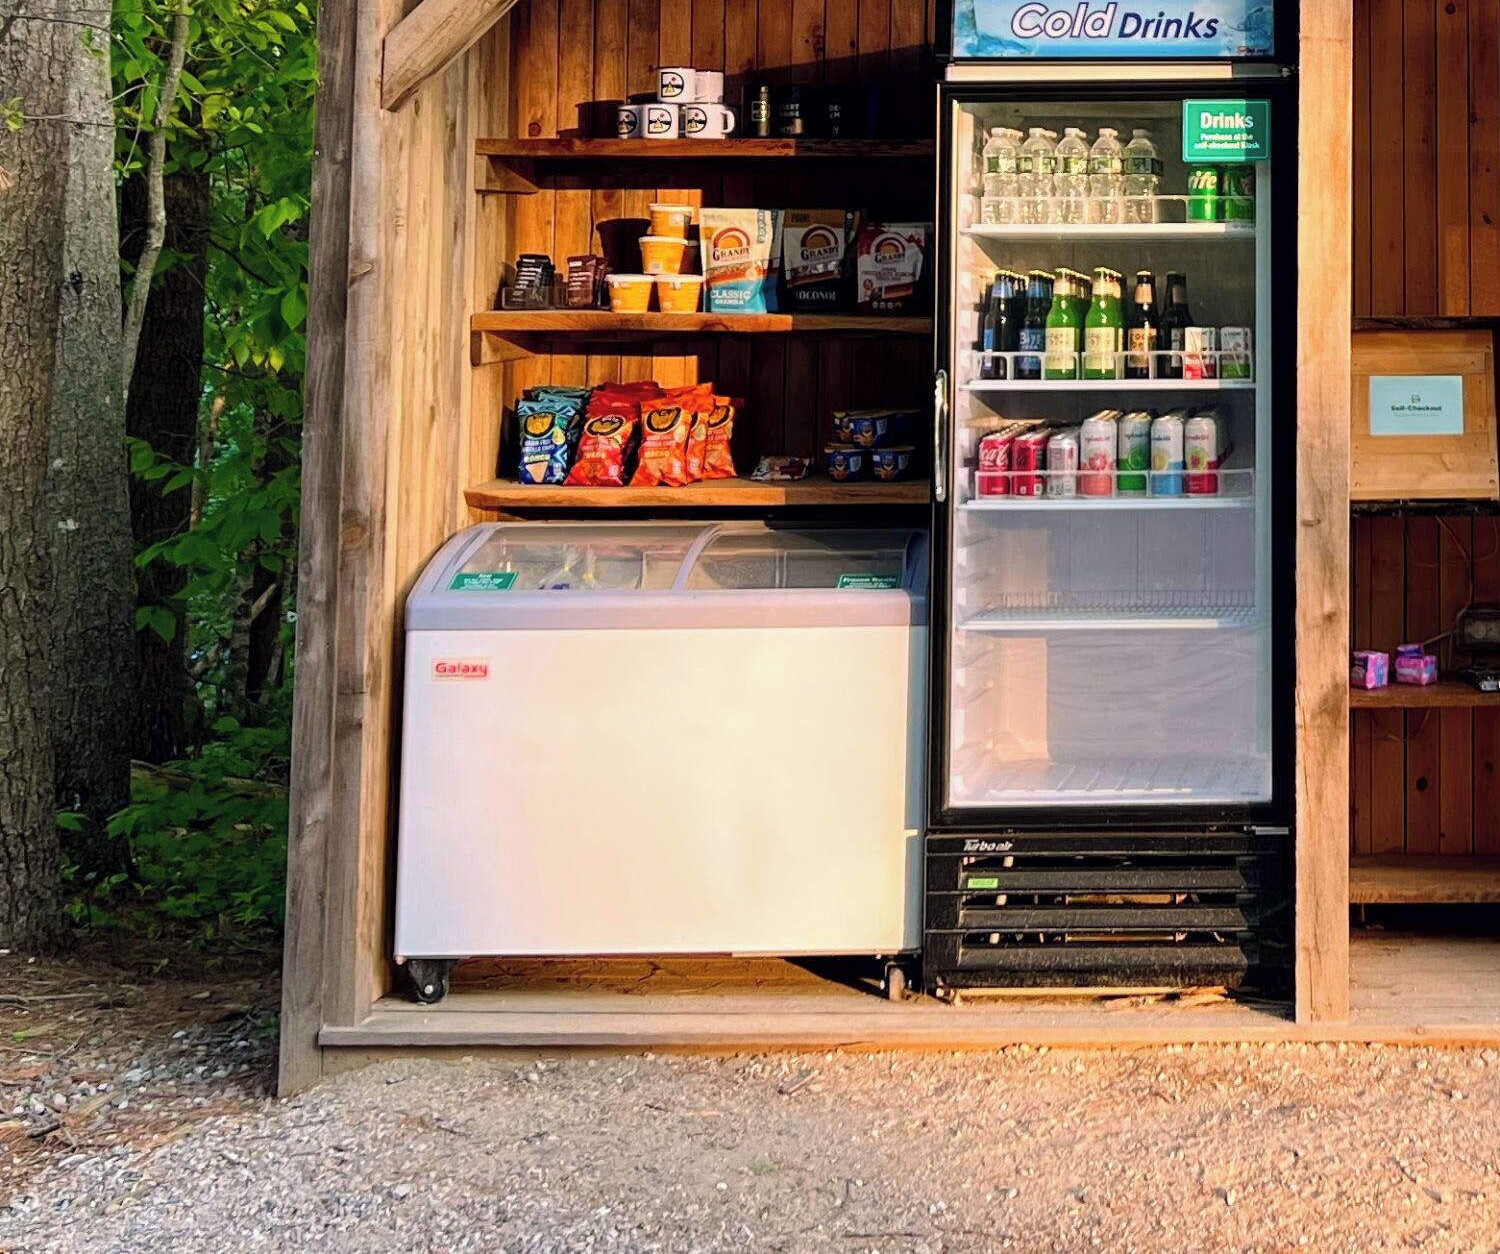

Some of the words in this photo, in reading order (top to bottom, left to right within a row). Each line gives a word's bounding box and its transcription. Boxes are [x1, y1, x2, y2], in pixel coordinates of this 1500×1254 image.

[1011, 2, 1117, 39] Cold
[1118, 11, 1219, 38] Drinks
[1201, 112, 1253, 128] Drinks
[711, 289, 751, 300] CLASSIC
[436, 662, 487, 677] Galaxy
[963, 839, 995, 851] Turbo
